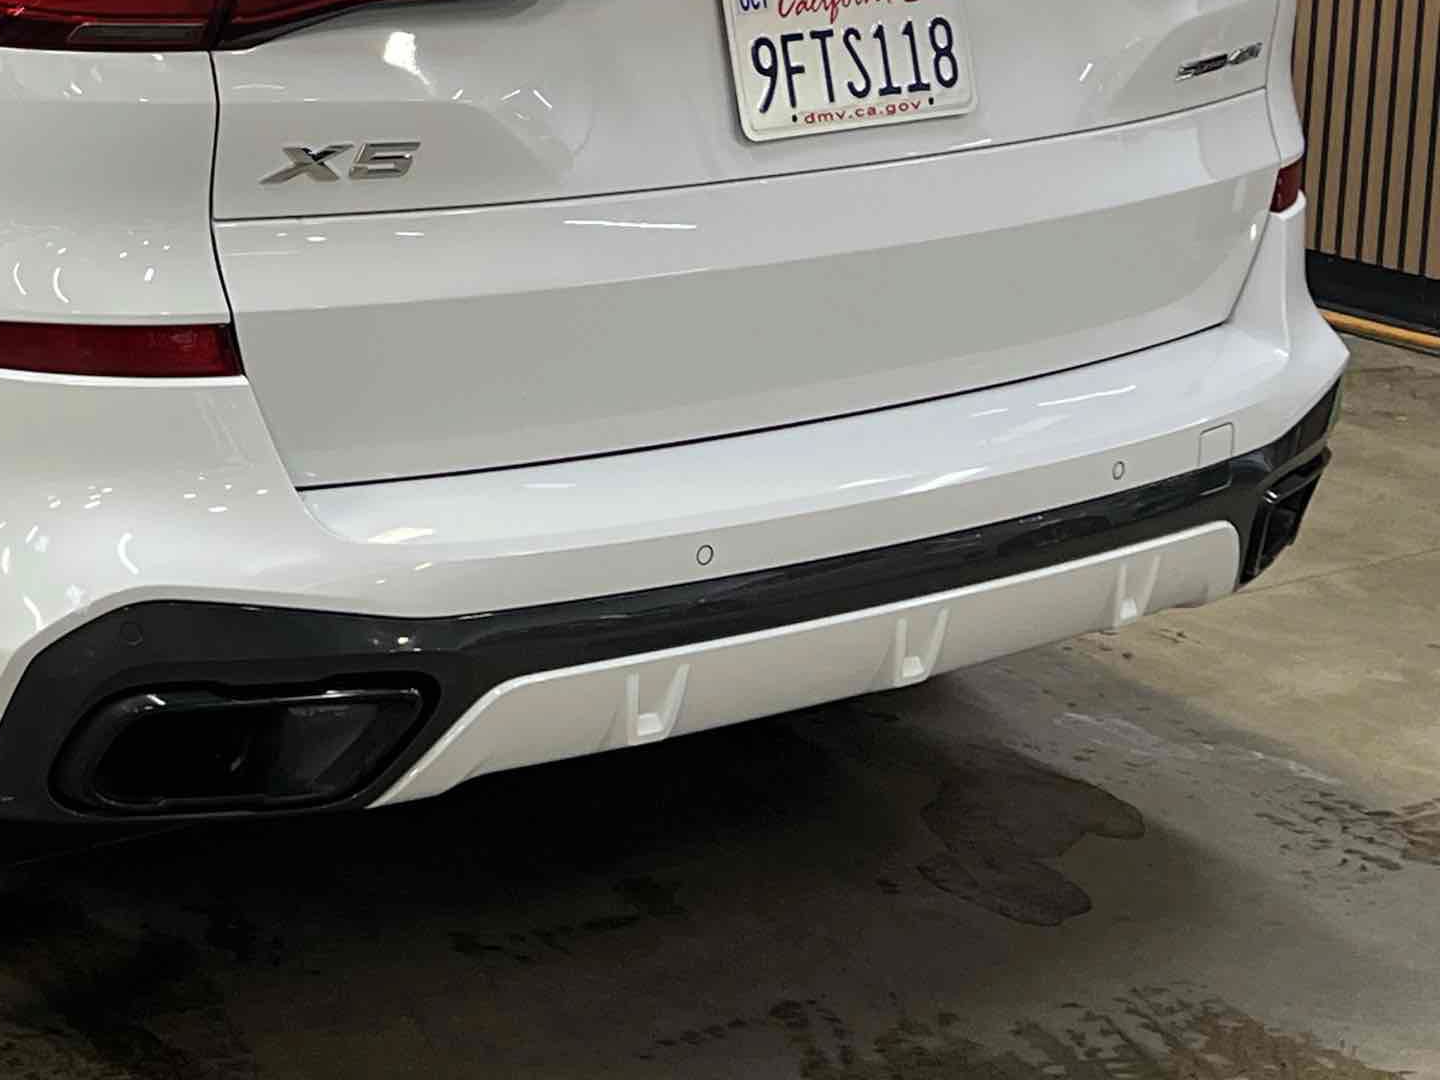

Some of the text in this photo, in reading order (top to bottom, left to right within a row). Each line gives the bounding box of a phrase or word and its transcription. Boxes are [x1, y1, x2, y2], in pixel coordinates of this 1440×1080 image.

[751, 17, 958, 114] 9FTS118
[804, 100, 921, 124] dmv.ca.gov
[259, 141, 421, 185] X5
